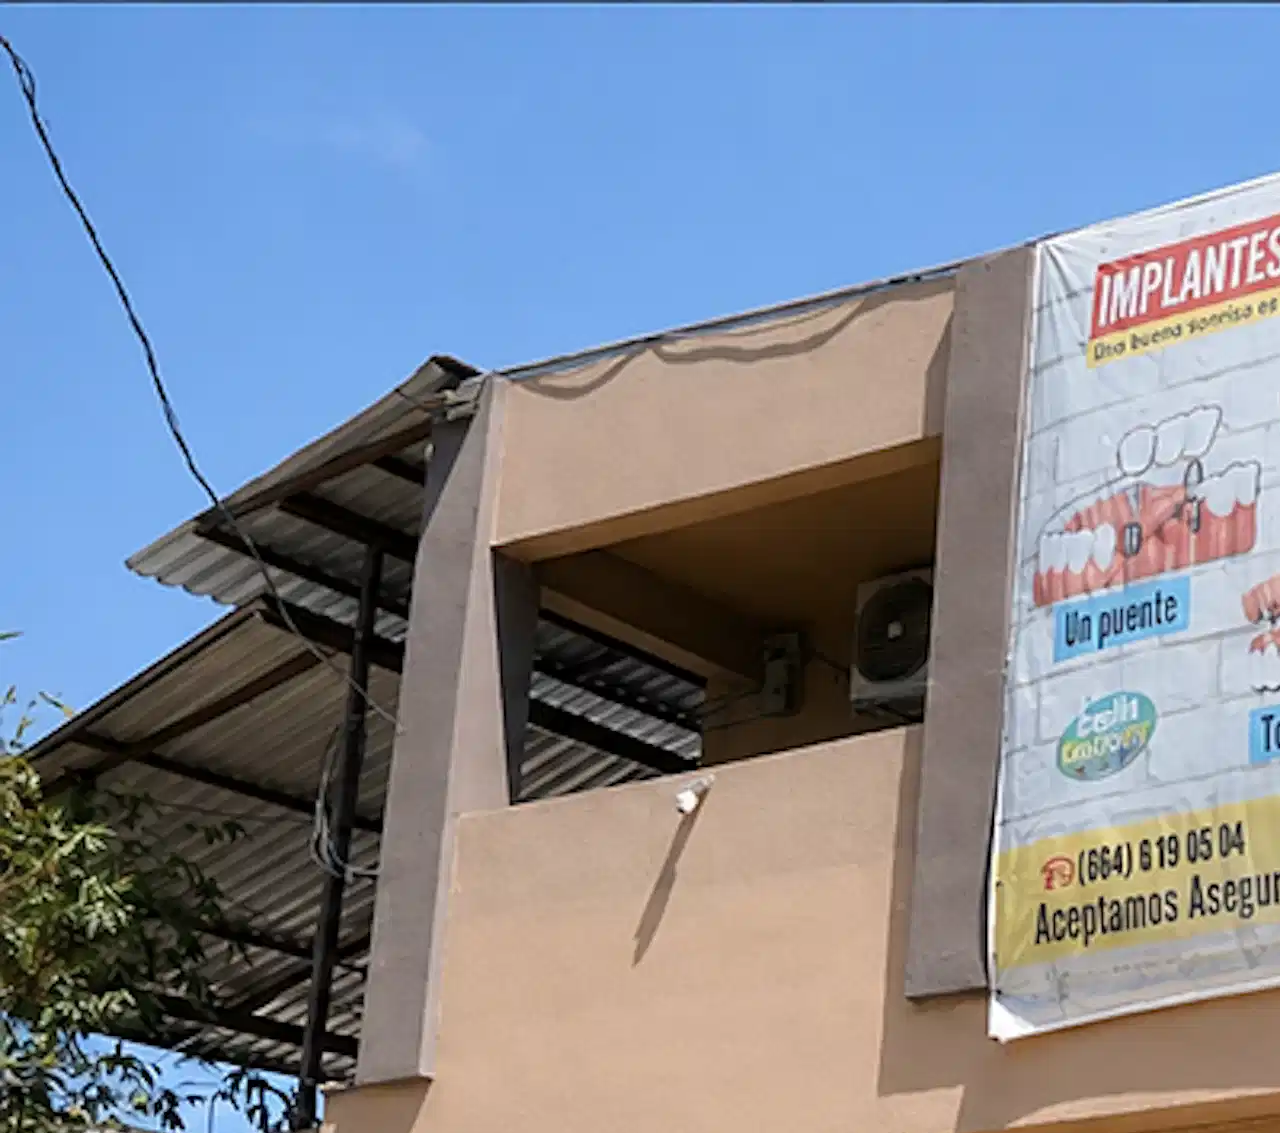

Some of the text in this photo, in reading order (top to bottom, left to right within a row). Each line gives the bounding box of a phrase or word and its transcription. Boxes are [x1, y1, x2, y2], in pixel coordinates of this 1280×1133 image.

[1257, 297, 1278, 314] es
[1065, 590, 1178, 648] Un puente
[1077, 842, 1132, 887] (664)
[1156, 833, 1179, 869] 19
[1186, 827, 1212, 864] 05
[1219, 820, 1245, 857] 04
[1034, 889, 1178, 948] Aceptamos
